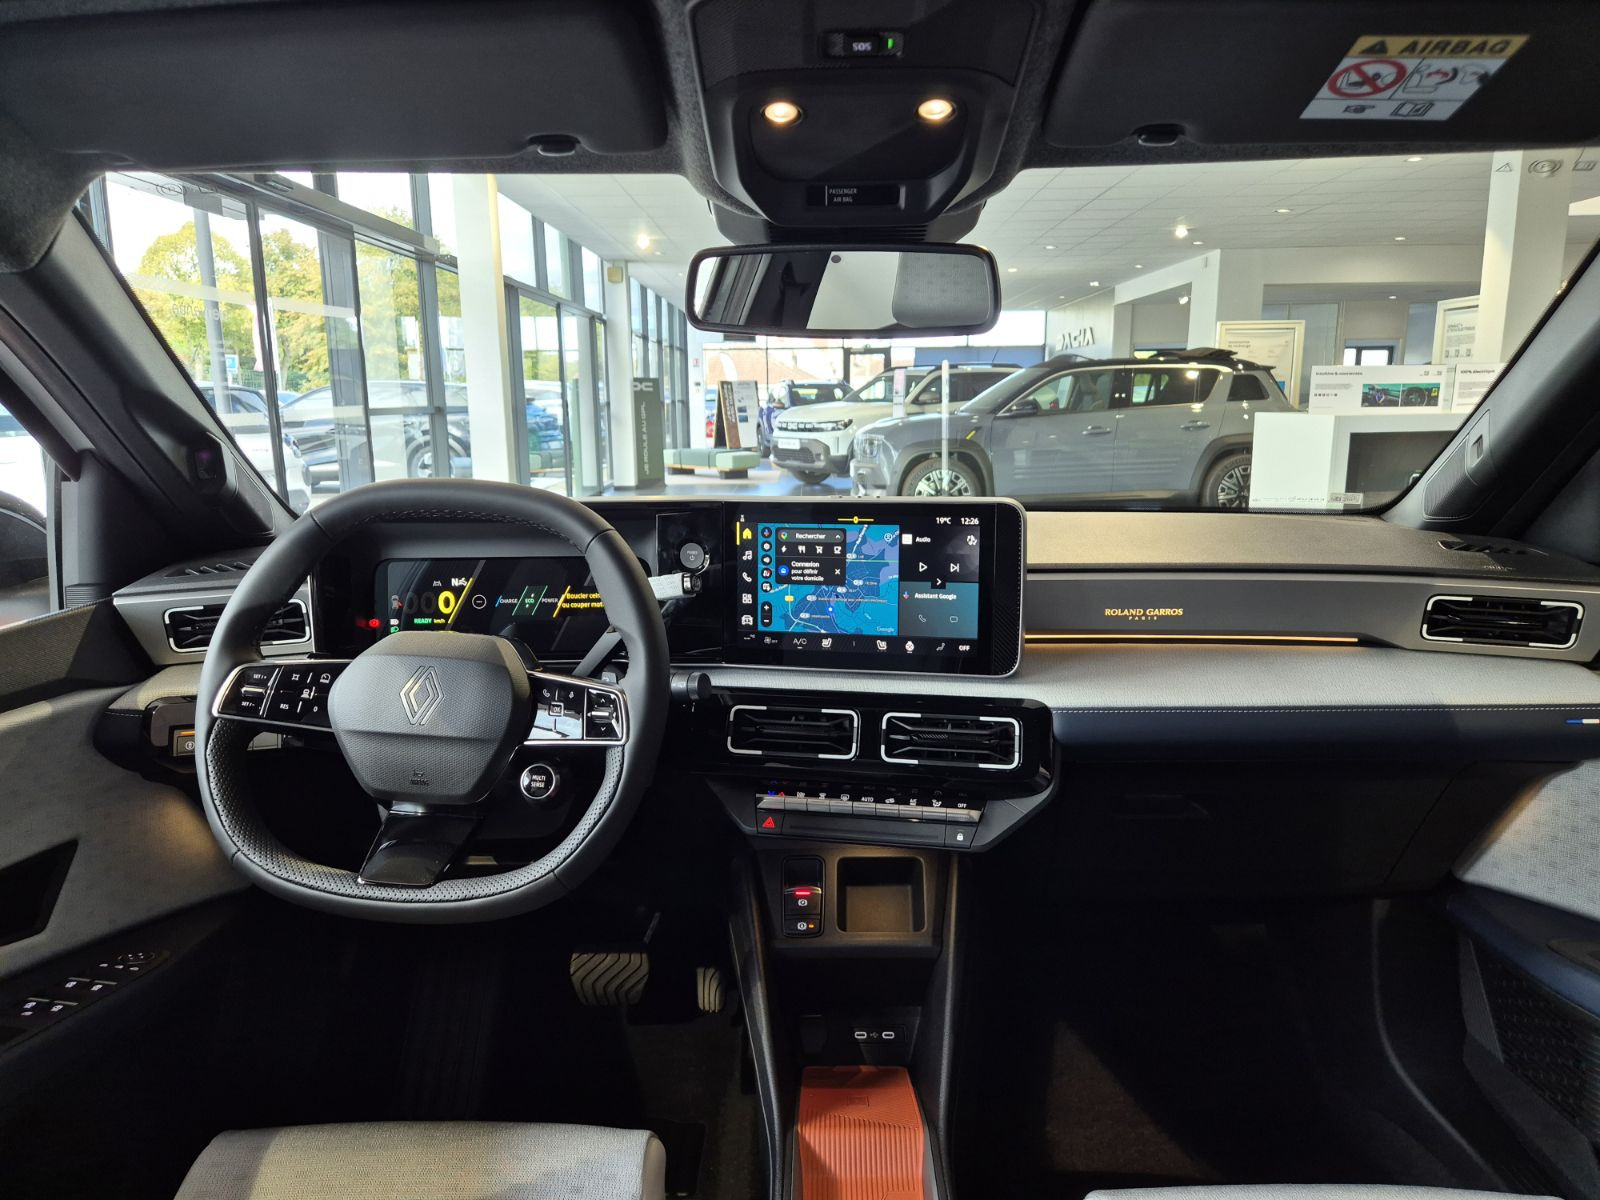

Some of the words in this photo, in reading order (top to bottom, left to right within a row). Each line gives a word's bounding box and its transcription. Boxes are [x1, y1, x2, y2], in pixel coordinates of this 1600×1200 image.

[852, 42, 872, 51] SOS
[1398, 39, 1512, 55] AIRBAG
[642, 421, 648, 432] AU
[936, 516, 952, 525] 19°C
[960, 517, 979, 525] 12:26
[795, 532, 826, 540] Rechercher
[1104, 608, 1144, 616] ROLAND
[1146, 608, 1184, 616] GARROS
[793, 637, 807, 645] A/C
